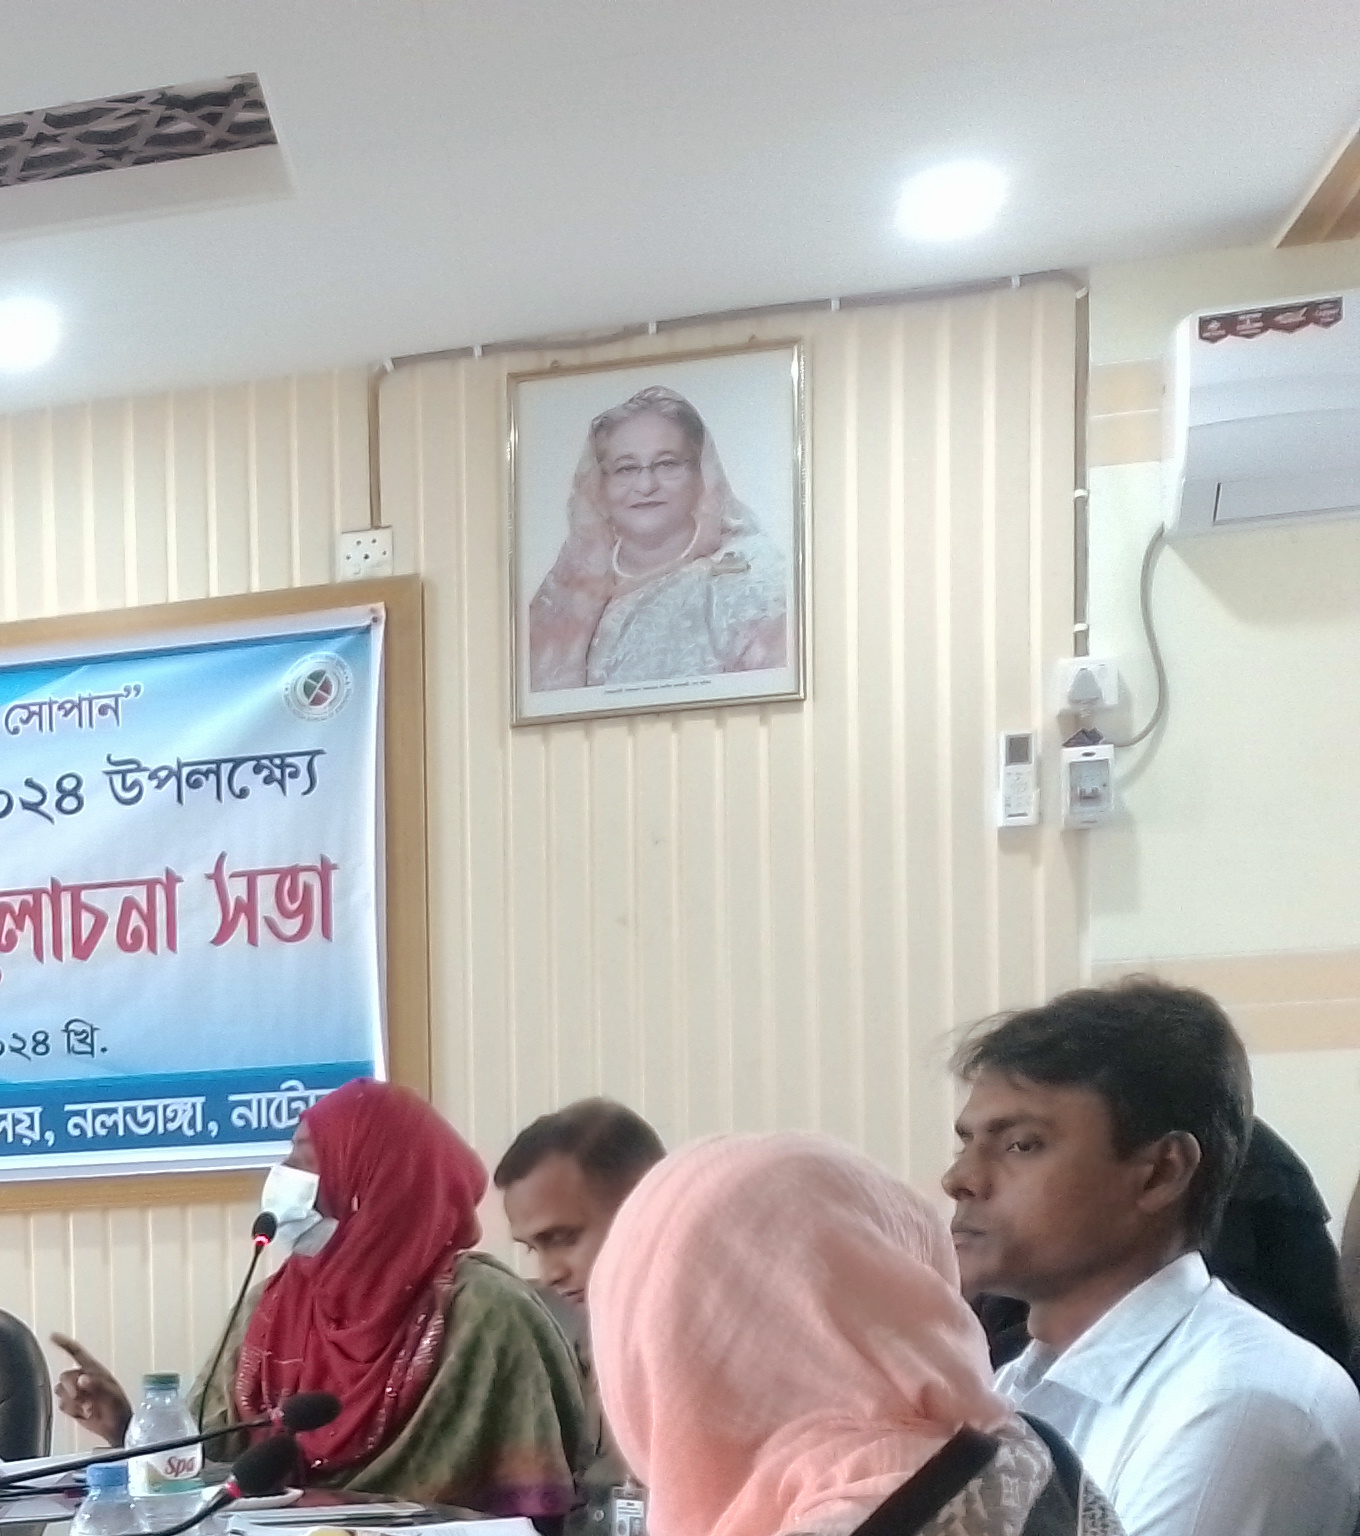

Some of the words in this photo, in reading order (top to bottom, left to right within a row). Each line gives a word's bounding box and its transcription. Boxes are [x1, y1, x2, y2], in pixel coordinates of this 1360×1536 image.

[102, 750, 326, 806] উপলক্ষ্যে
[204, 850, 339, 948] সভা
[227, 1080, 338, 1130] নাটো
[164, 1456, 197, 1478] Spa
